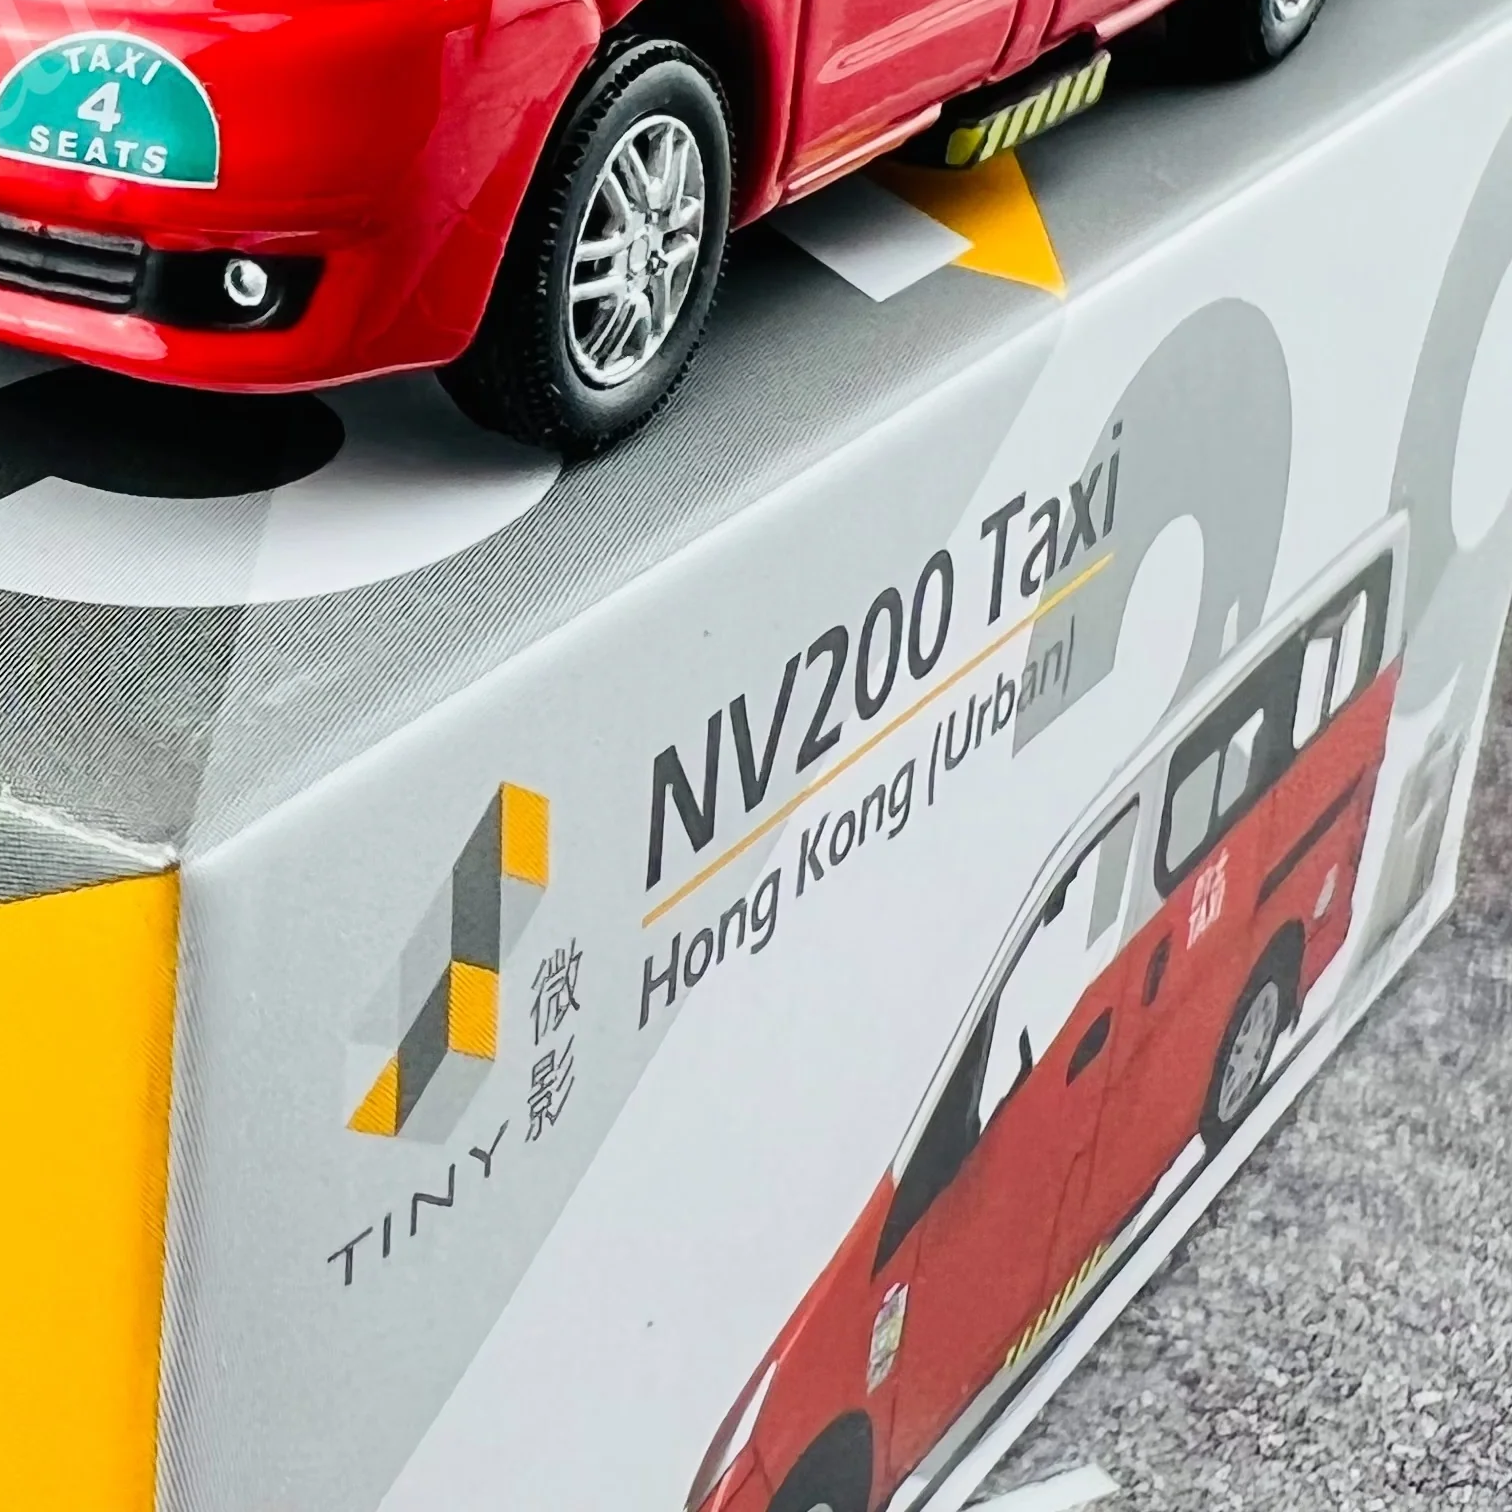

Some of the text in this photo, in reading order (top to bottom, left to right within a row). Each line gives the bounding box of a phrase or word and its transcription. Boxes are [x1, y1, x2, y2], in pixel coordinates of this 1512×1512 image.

[29, 124, 168, 174] SEATS
[62, 43, 162, 86] TAXI
[77, 81, 122, 132] 4
[646, 419, 1123, 892] NV200 Taxi
[638, 868, 781, 1031] Hong
[796, 758, 916, 898] Kong
[524, 937, 583, 1144] 微影
[326, 1118, 510, 1287] TINY
